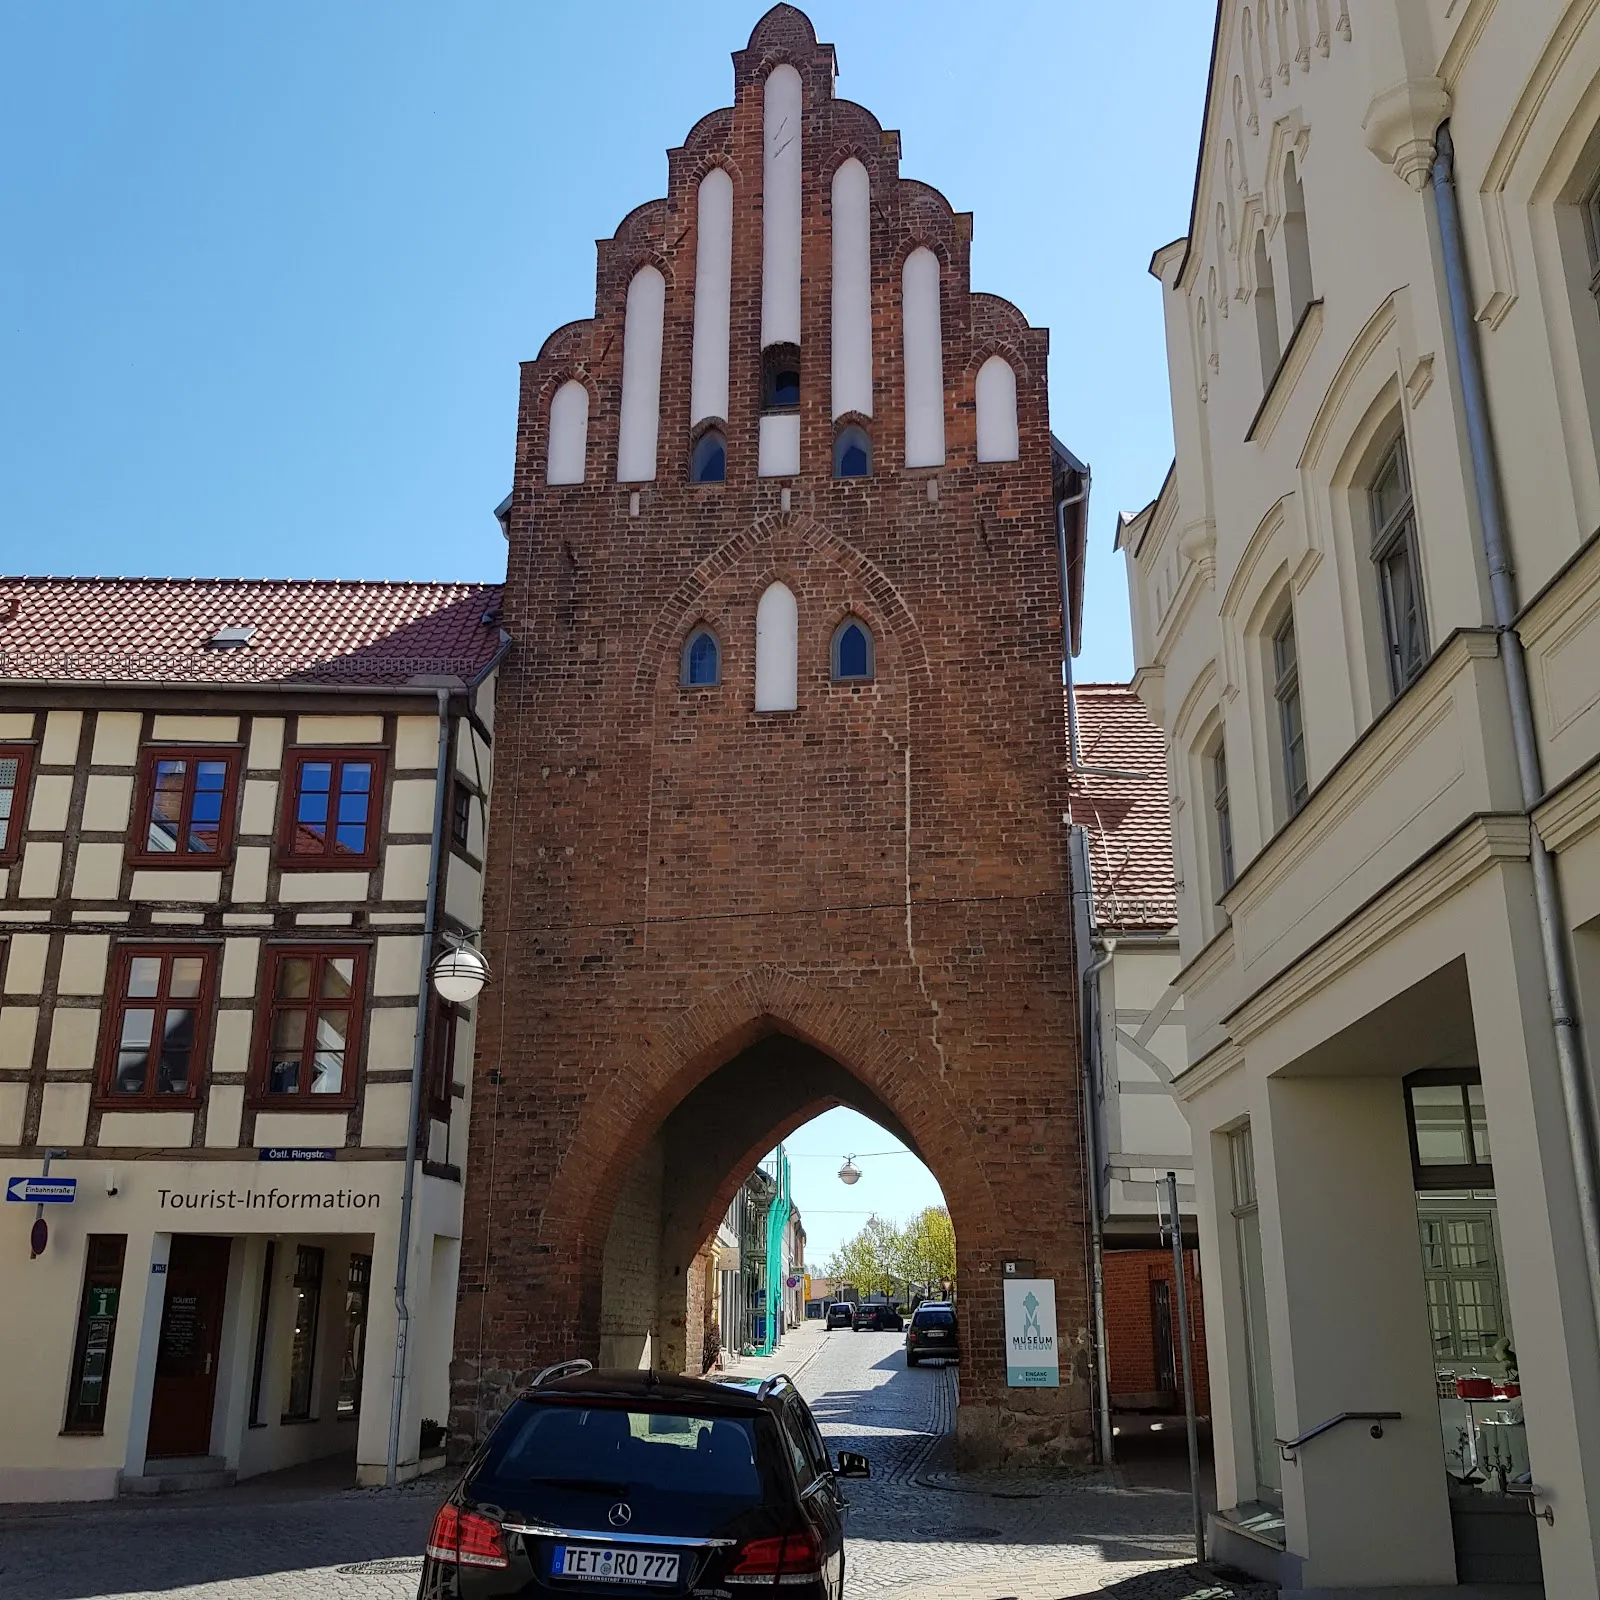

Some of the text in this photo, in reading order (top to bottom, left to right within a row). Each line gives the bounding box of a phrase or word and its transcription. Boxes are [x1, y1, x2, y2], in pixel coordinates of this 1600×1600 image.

[269, 1149, 325, 1160] Östl. Ringstr.
[25, 1186, 71, 1194] Einbahnstraße
[158, 1188, 381, 1209] Tourist-Information
[172, 1296, 198, 1304] TOURIST
[1012, 1336, 1053, 1344] MUSEUM
[566, 1550, 678, 1579] TET RO 777
